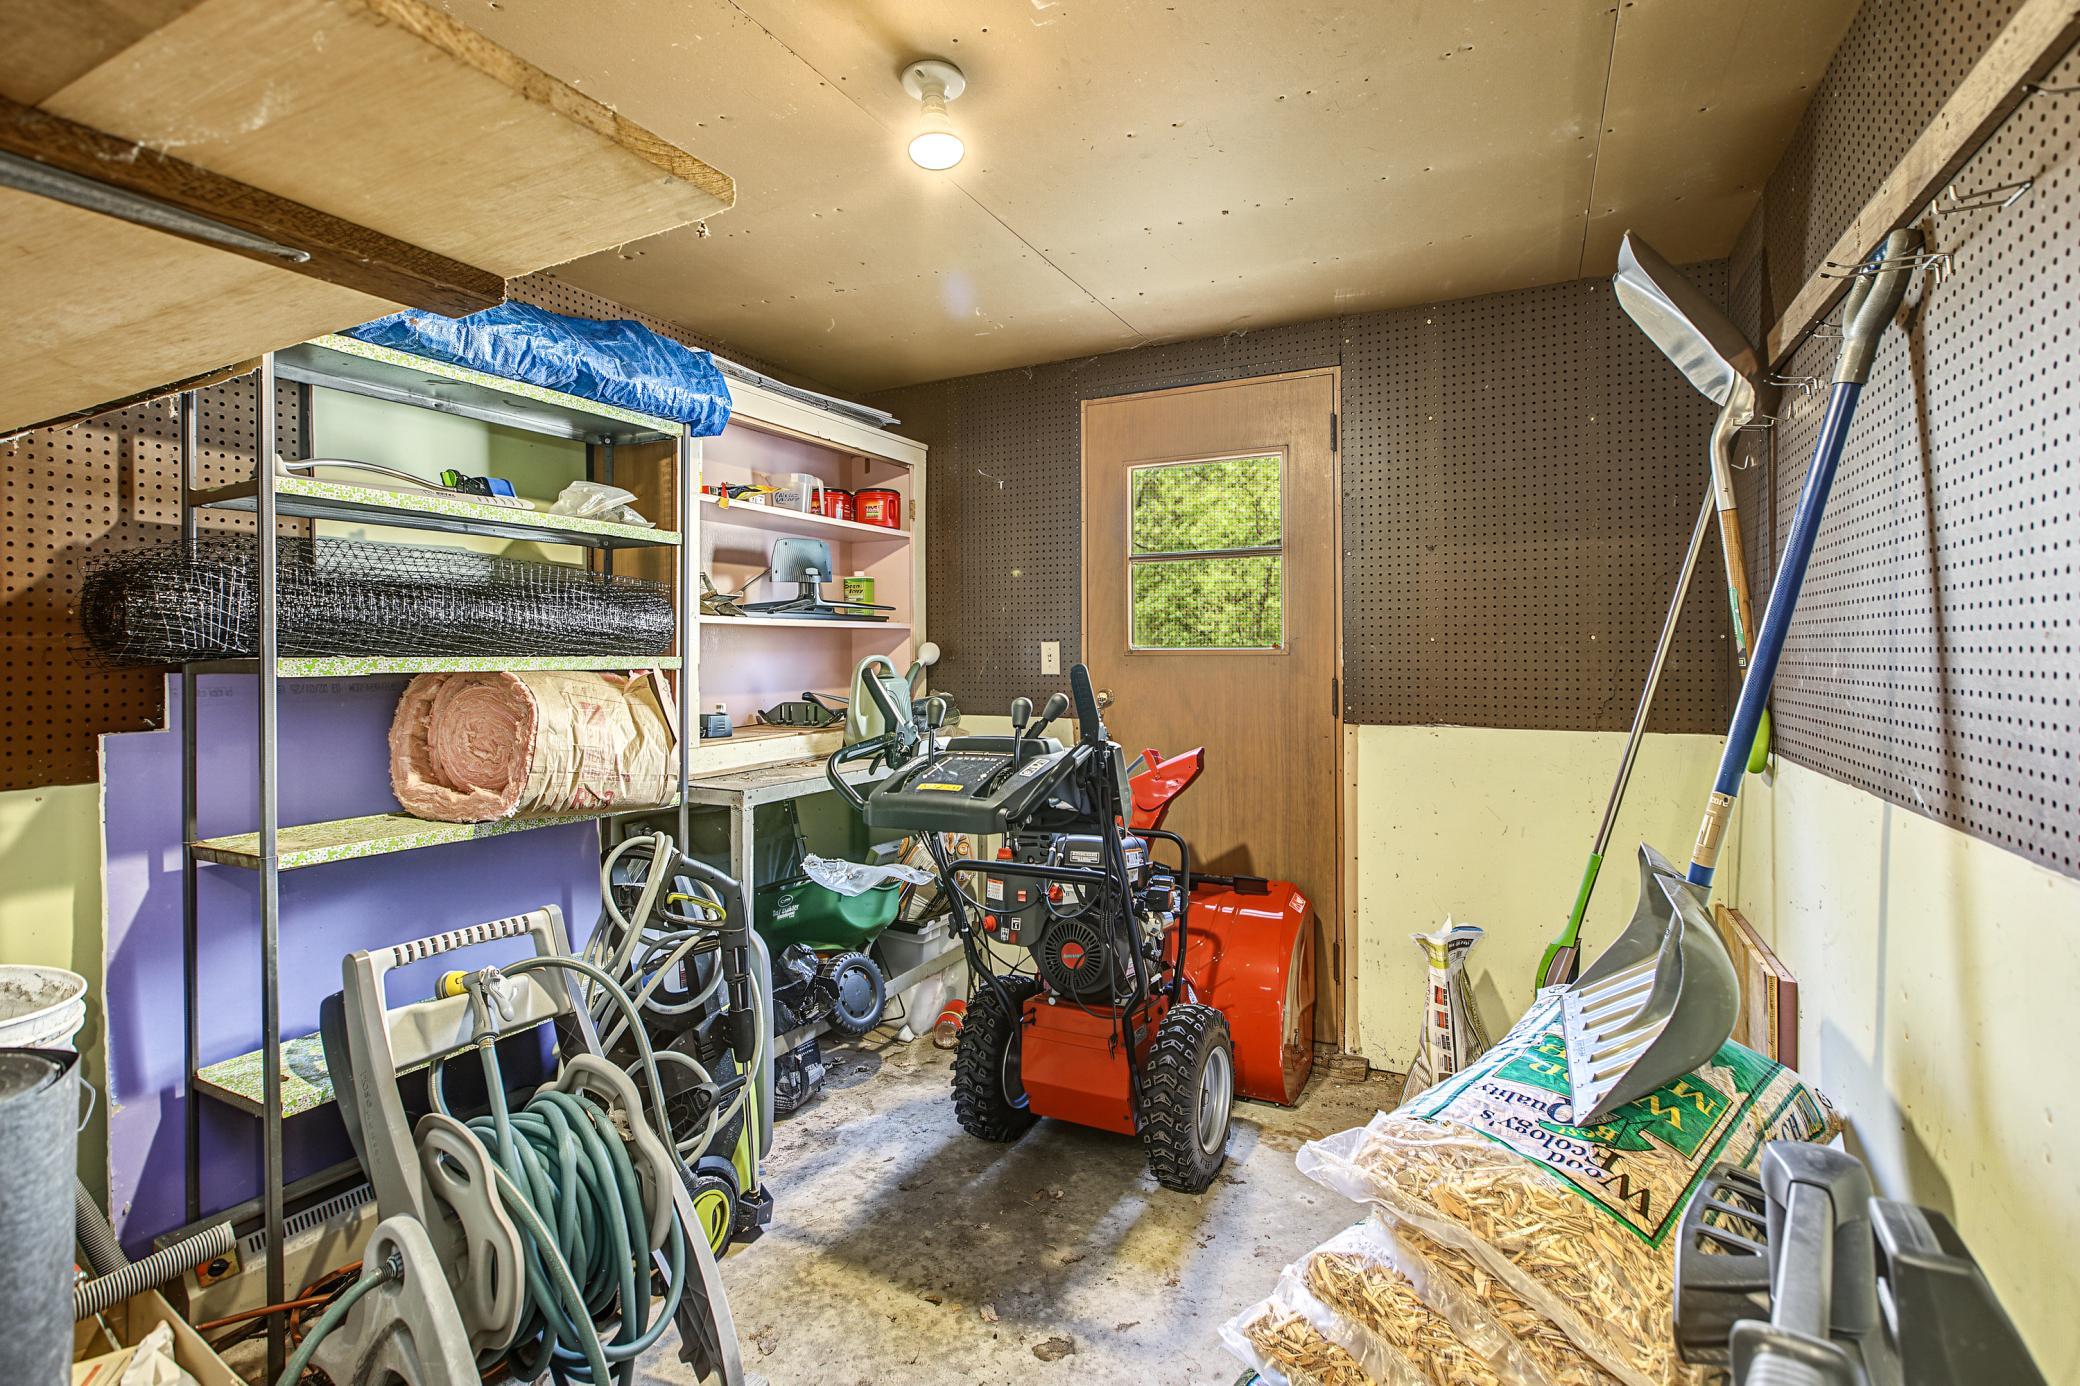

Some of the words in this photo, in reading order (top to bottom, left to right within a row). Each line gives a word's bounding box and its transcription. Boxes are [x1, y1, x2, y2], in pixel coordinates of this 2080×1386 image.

[1475, 1082, 1574, 1124] Quality
[1480, 1108, 1625, 1175] Ecology's
[1557, 1123, 1618, 1142] Best
[1545, 1151, 1653, 1225] Wood
